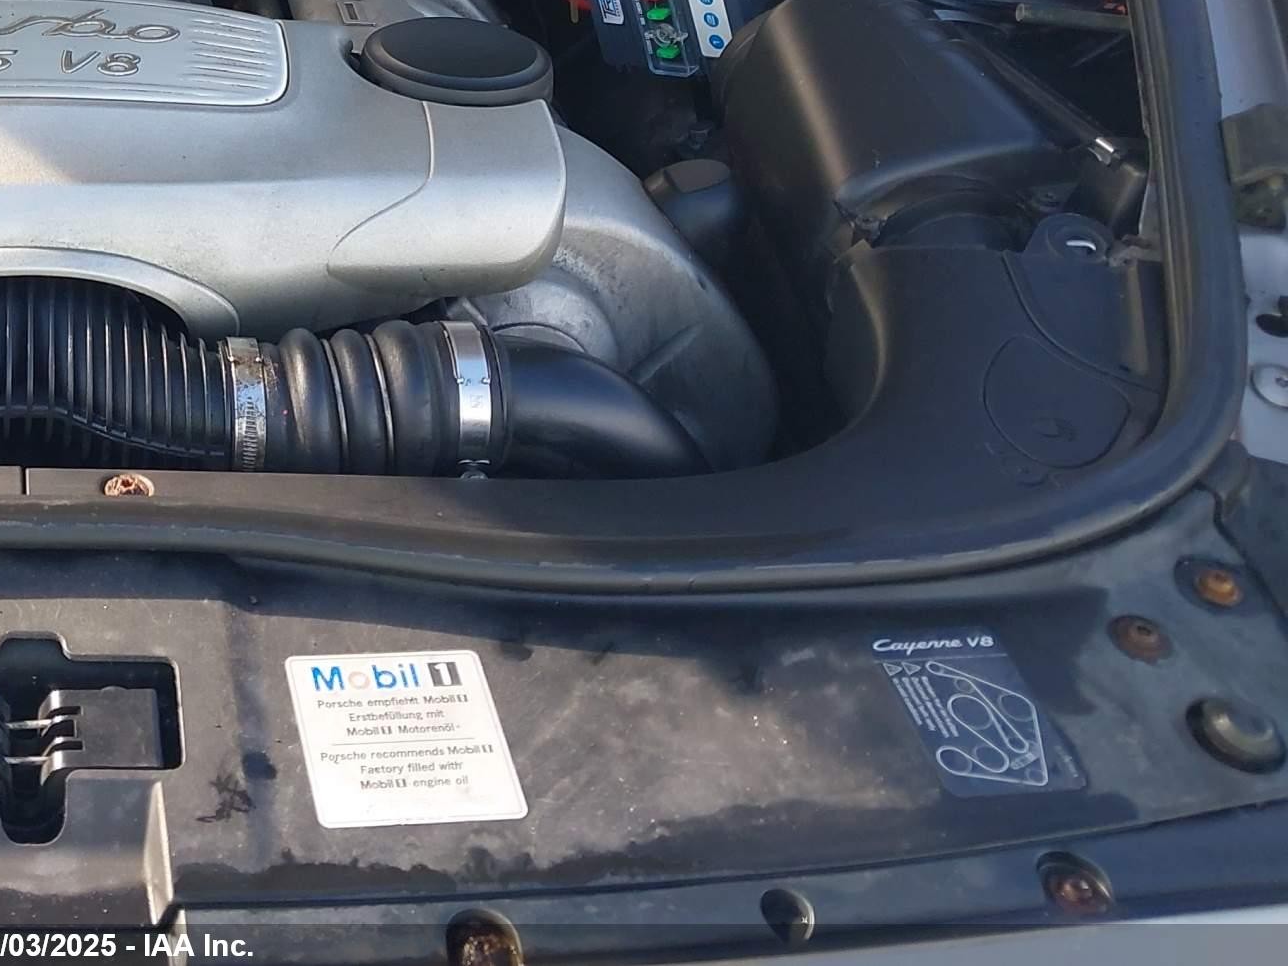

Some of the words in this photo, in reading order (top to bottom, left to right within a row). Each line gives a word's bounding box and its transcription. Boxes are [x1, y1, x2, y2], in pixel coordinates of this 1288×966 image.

[711, 36, 722, 48] 1
[60, 50, 142, 76] V8
[873, 638, 962, 656] Cayenne
[966, 635, 994, 647] V8
[312, 664, 419, 691] Mobil
[318, 699, 362, 709] Porsche
[320, 751, 366, 762] Porsche
[371, 748, 444, 759] recommends
[361, 764, 403, 775] Factory
[407, 762, 435, 773] filled
[439, 761, 463, 771] with
[413, 778, 451, 790] engine
[456, 776, 469, 786] oil
